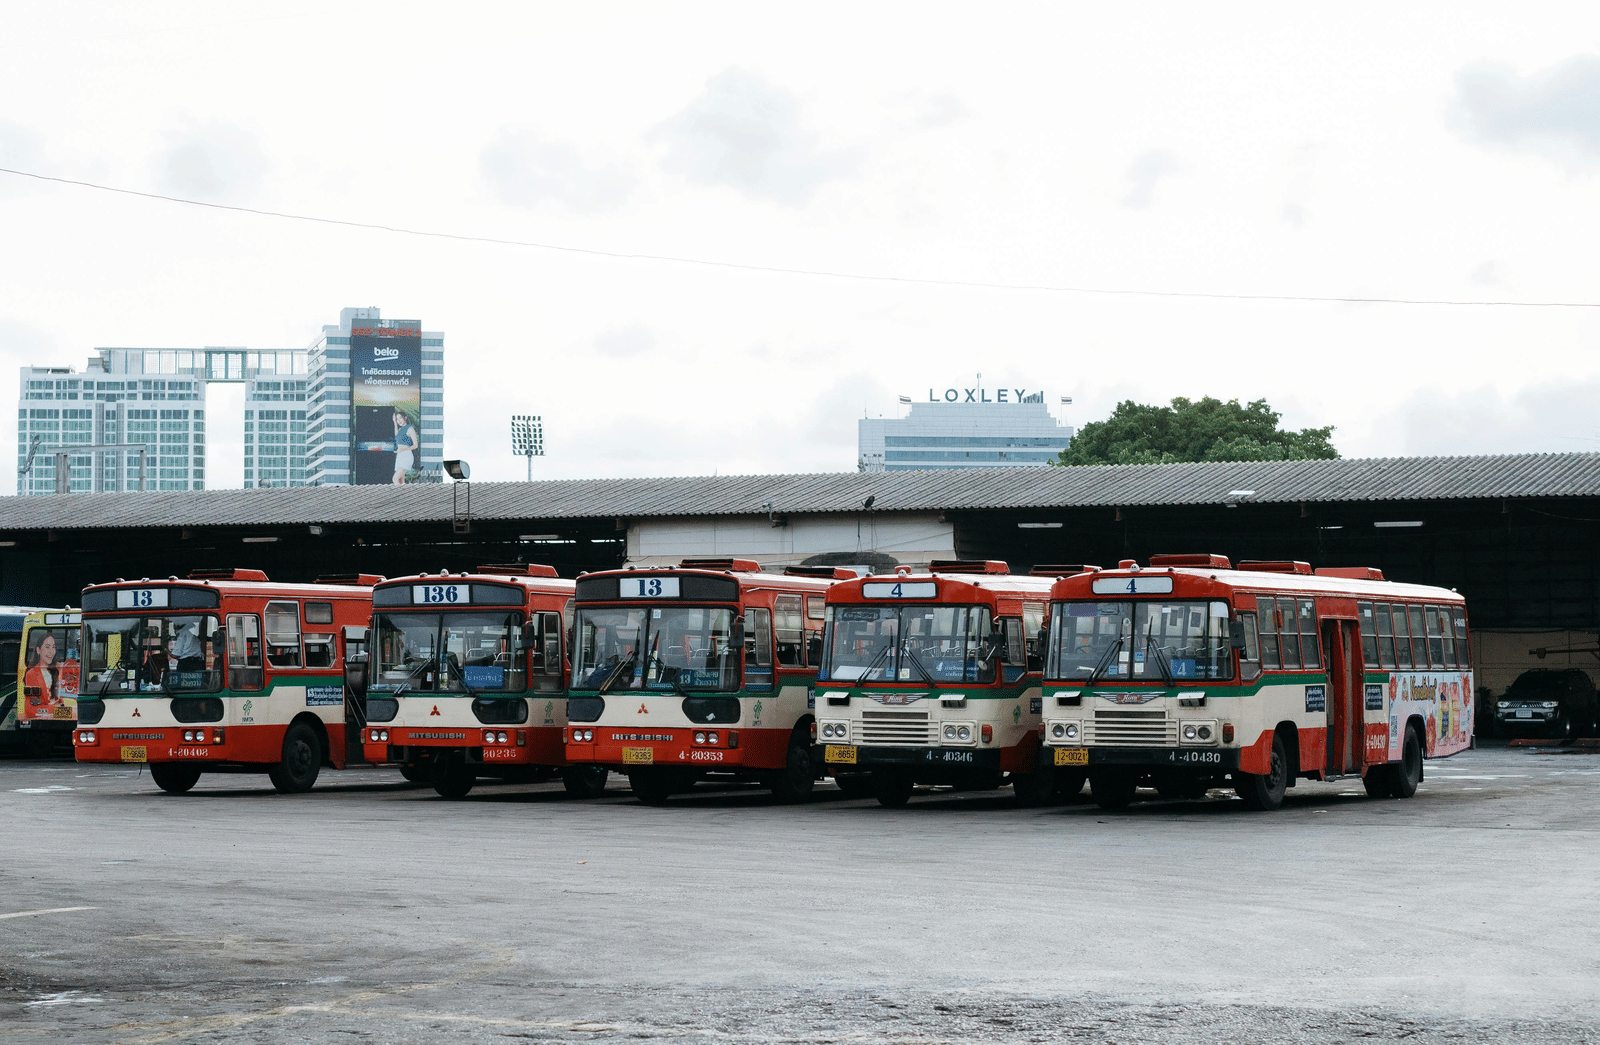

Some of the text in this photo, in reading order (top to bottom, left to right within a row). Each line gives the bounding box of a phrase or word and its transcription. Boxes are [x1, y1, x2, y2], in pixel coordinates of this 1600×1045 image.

[374, 347, 399, 356] beko
[929, 388, 1026, 403] LOXLEY
[636, 579, 662, 597] 13
[891, 583, 903, 598] 4
[1126, 579, 1137, 593] 4
[132, 590, 152, 607] 13
[422, 585, 458, 603] 136
[60, 614, 70, 624] 47
[936, 662, 943, 672] 4
[1177, 661, 1186, 676] 4
[169, 675, 178, 685] 13
[680, 674, 691, 684] 13
[483, 749, 517, 758] 80235
[678, 750, 724, 761] 4-80353
